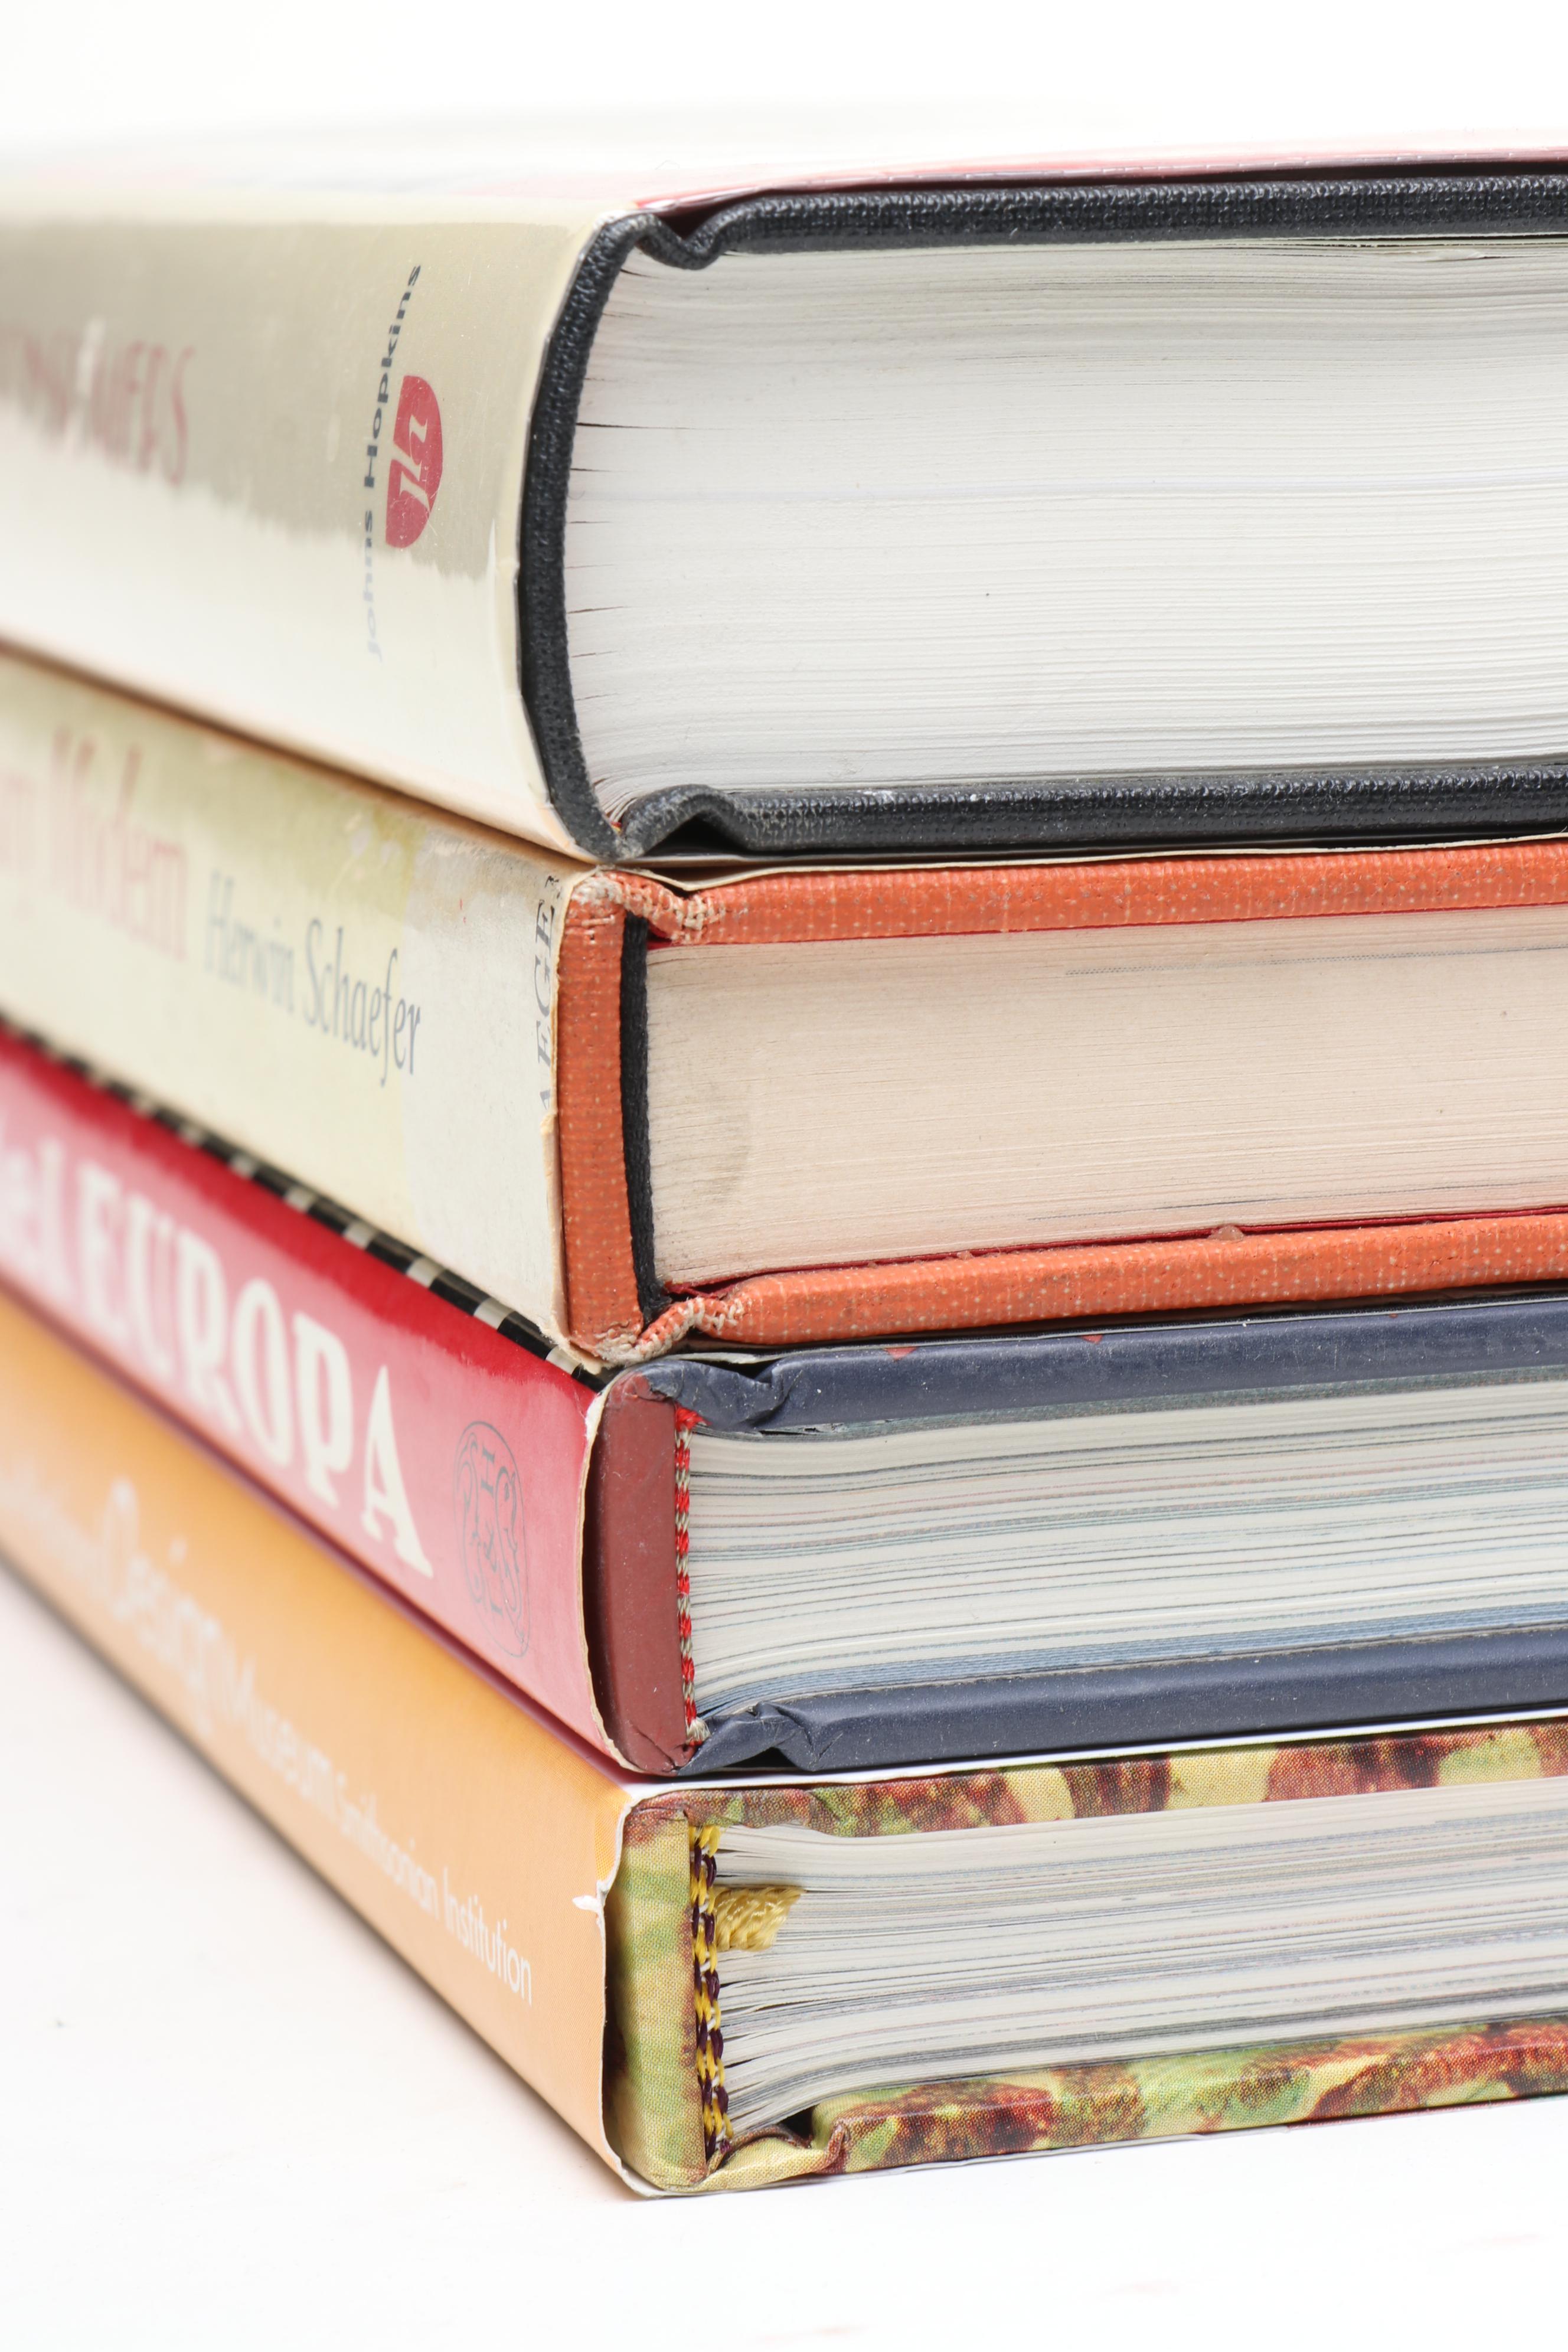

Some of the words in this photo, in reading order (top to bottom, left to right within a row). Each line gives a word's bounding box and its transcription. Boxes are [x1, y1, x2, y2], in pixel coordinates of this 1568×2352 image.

[363, 264, 421, 489] Hopkins
[362, 509, 383, 665] Johns
[204, 869, 295, 1015] Herwin
[303, 918, 421, 1088] Schaefer
[77, 1158, 434, 1578] EUROPA
[442, 1866, 533, 2008] Institution
